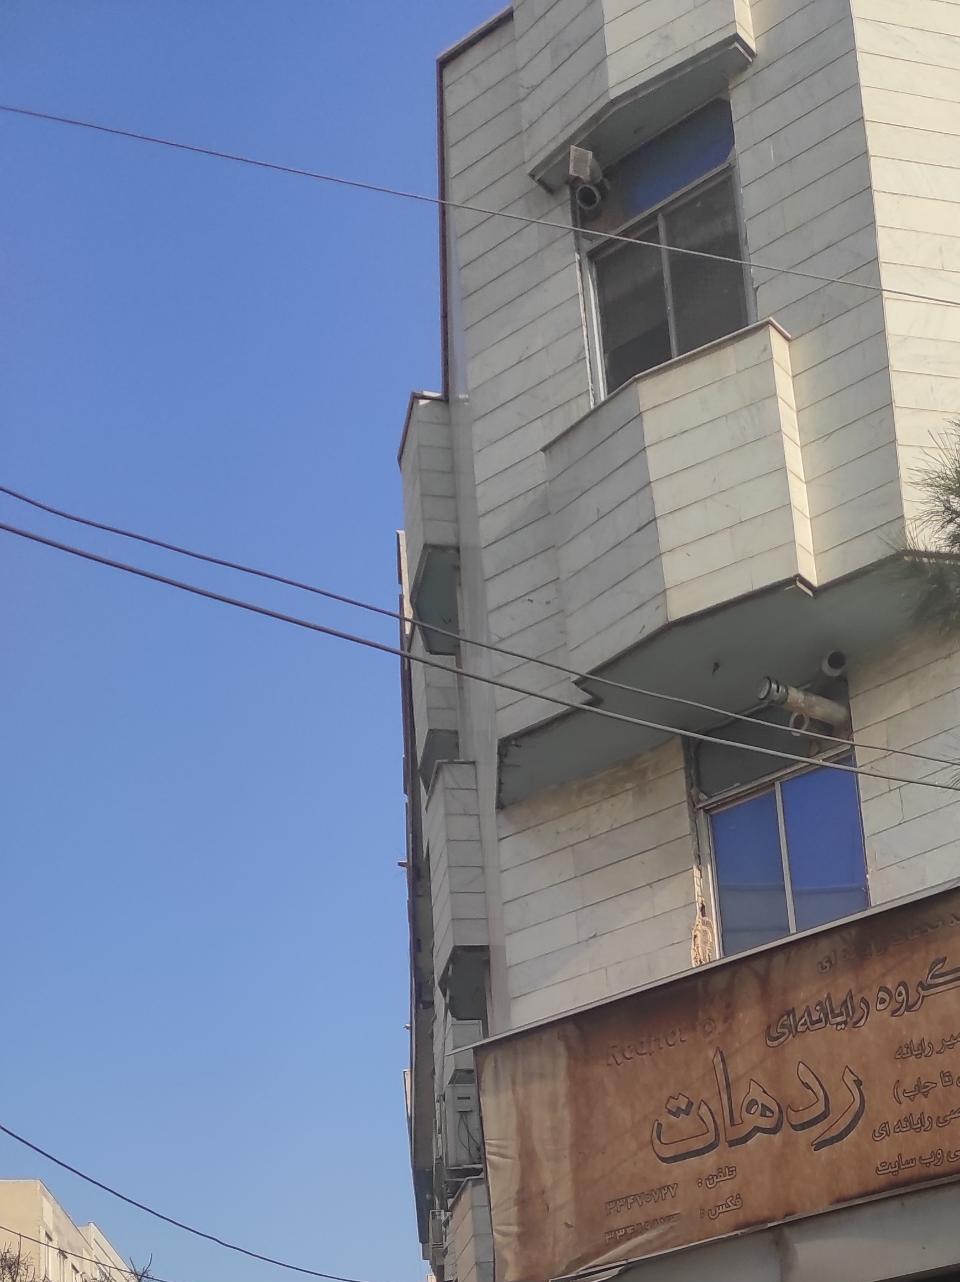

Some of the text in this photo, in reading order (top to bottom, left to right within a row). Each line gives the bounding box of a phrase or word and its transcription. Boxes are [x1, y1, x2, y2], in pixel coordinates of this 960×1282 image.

[895, 1036, 934, 1060] رایانه
[940, 1070, 953, 1088] تا
[651, 1047, 866, 1164] ردهات
[875, 1153, 916, 1177] سایت
[919, 1149, 945, 1166] وب
